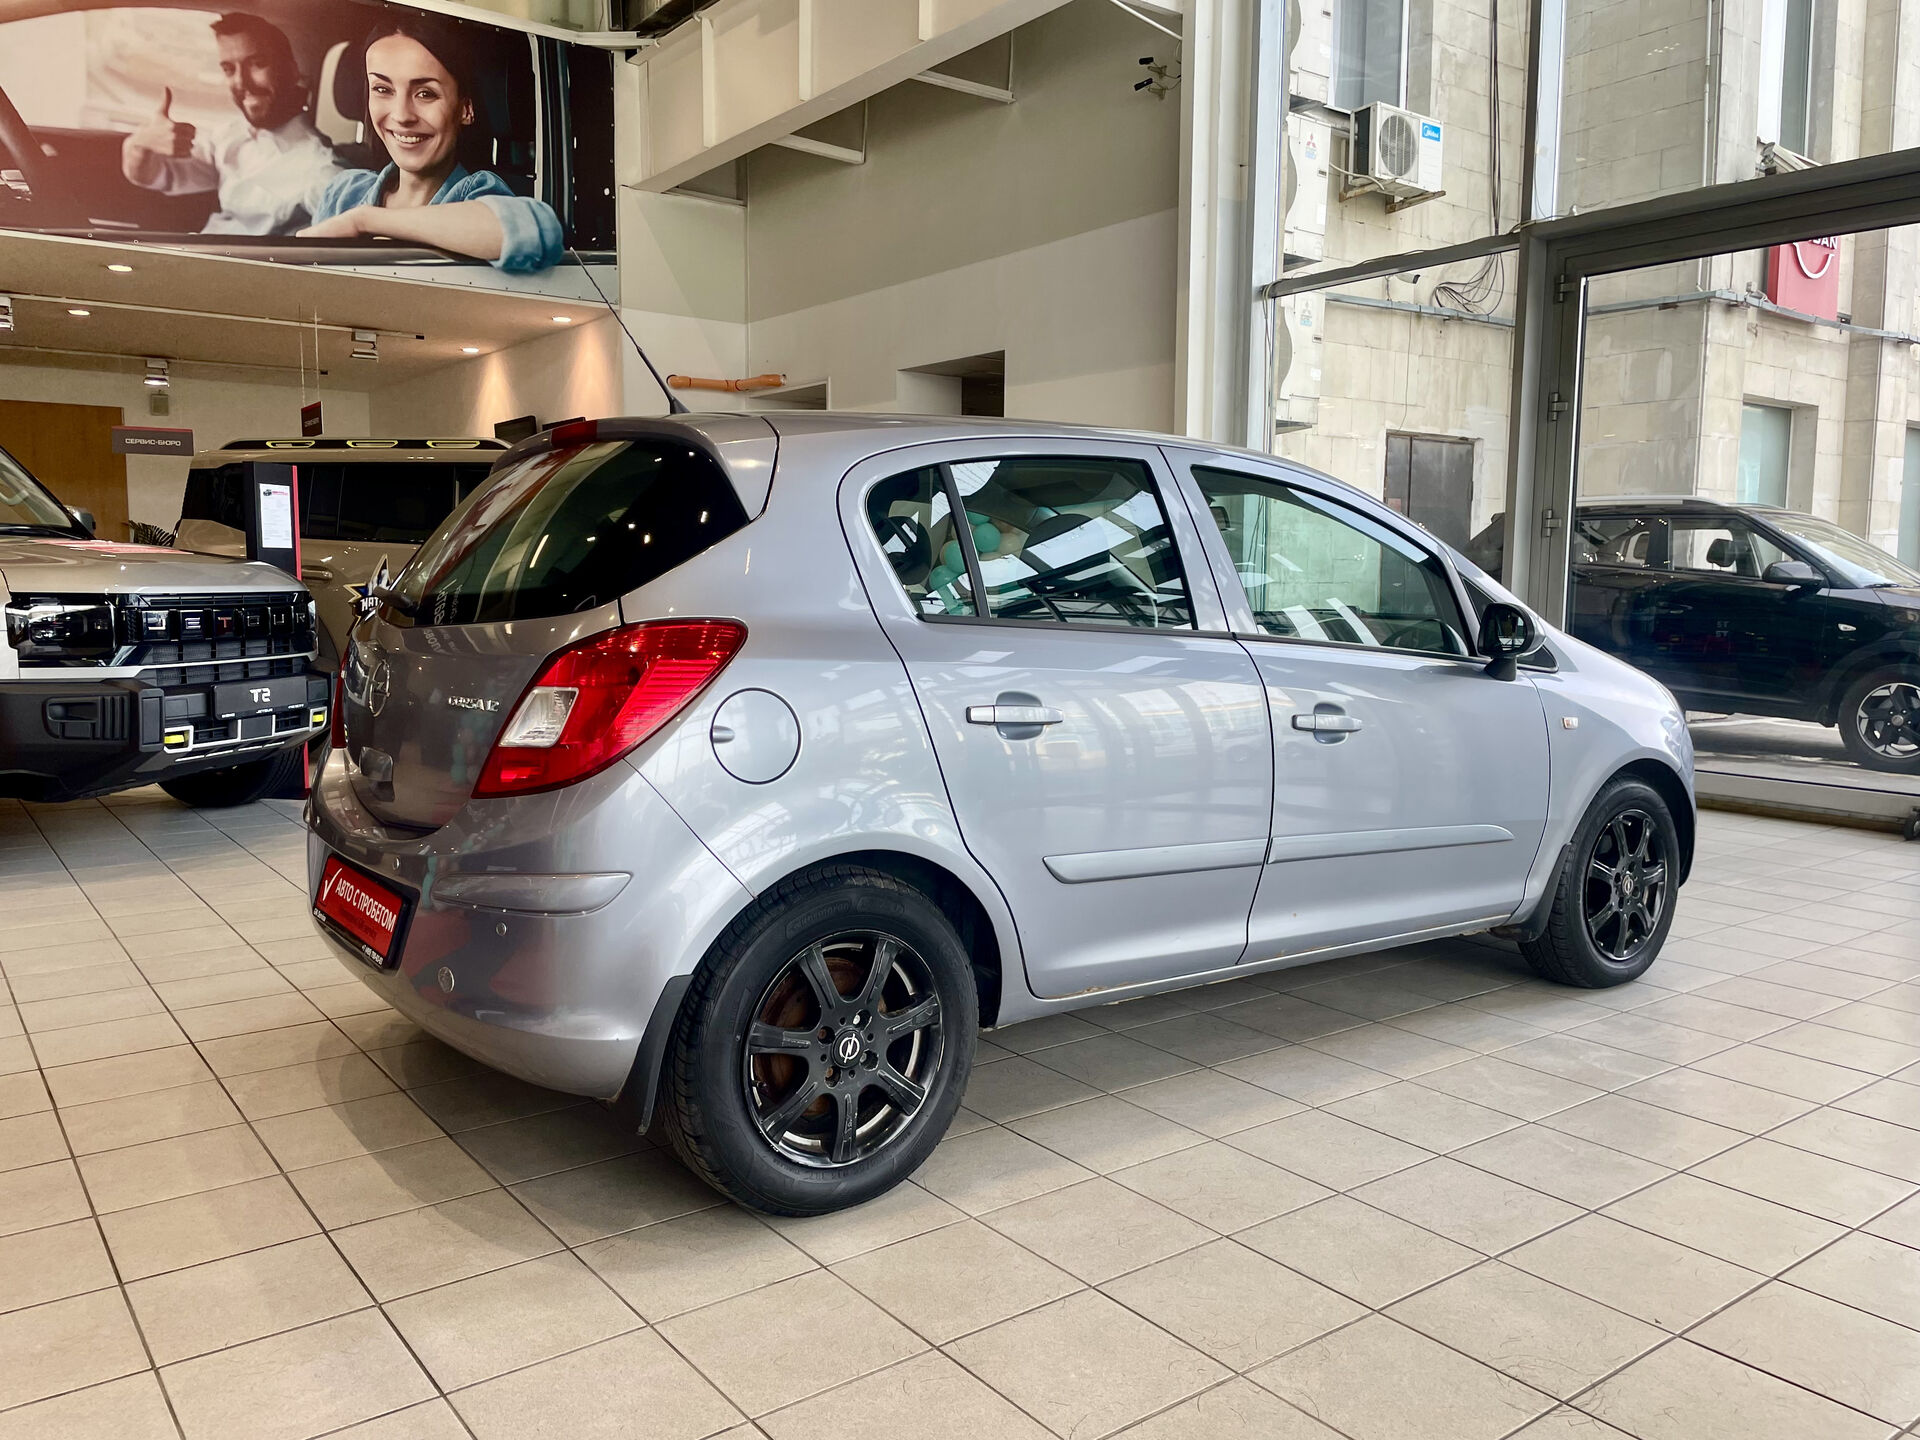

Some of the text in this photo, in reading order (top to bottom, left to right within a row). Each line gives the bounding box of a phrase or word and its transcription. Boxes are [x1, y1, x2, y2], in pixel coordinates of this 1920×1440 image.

[125, 438, 181, 446] СЕРВИС-БЮРО
[148, 613, 306, 631] JETOUR
[249, 687, 271, 703] T2
[335, 878, 397, 932] АВТО С ПРОБЕГОМ
